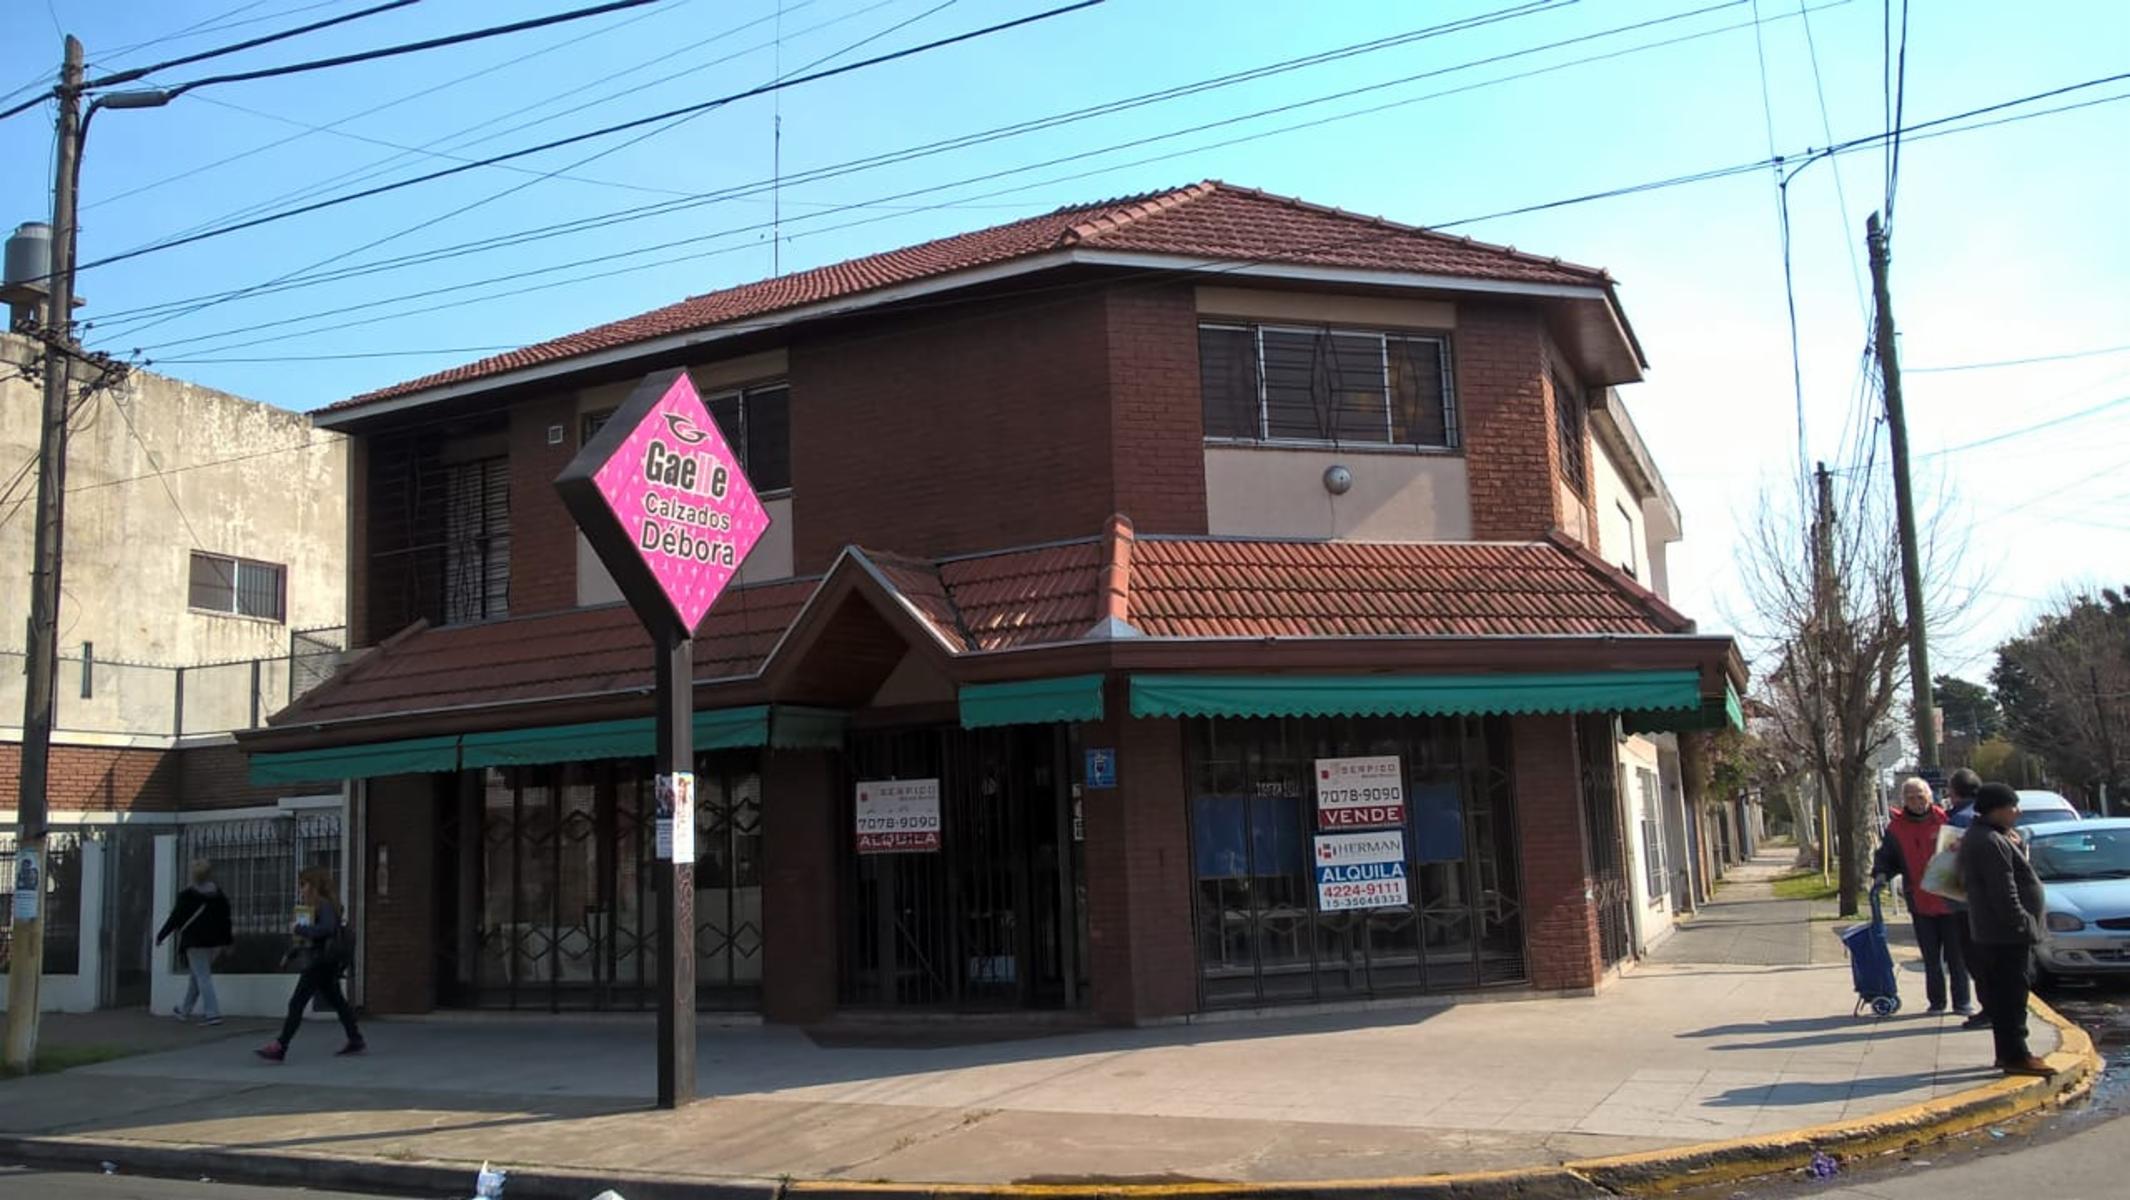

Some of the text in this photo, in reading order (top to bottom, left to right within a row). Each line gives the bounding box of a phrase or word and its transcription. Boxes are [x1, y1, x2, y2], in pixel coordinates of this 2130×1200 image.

[645, 440, 727, 499] Gaelle
[645, 493, 730, 531] Calzados
[642, 520, 735, 566] Débora
[1321, 787, 1400, 803] 7078-9090
[858, 816, 937, 829] 7078-9090
[1325, 807, 1399, 823] VENDE
[1338, 840, 1400, 854] HERMAN
[1322, 863, 1405, 882] ALQUILA
[1324, 883, 1399, 897] 4224-9111
